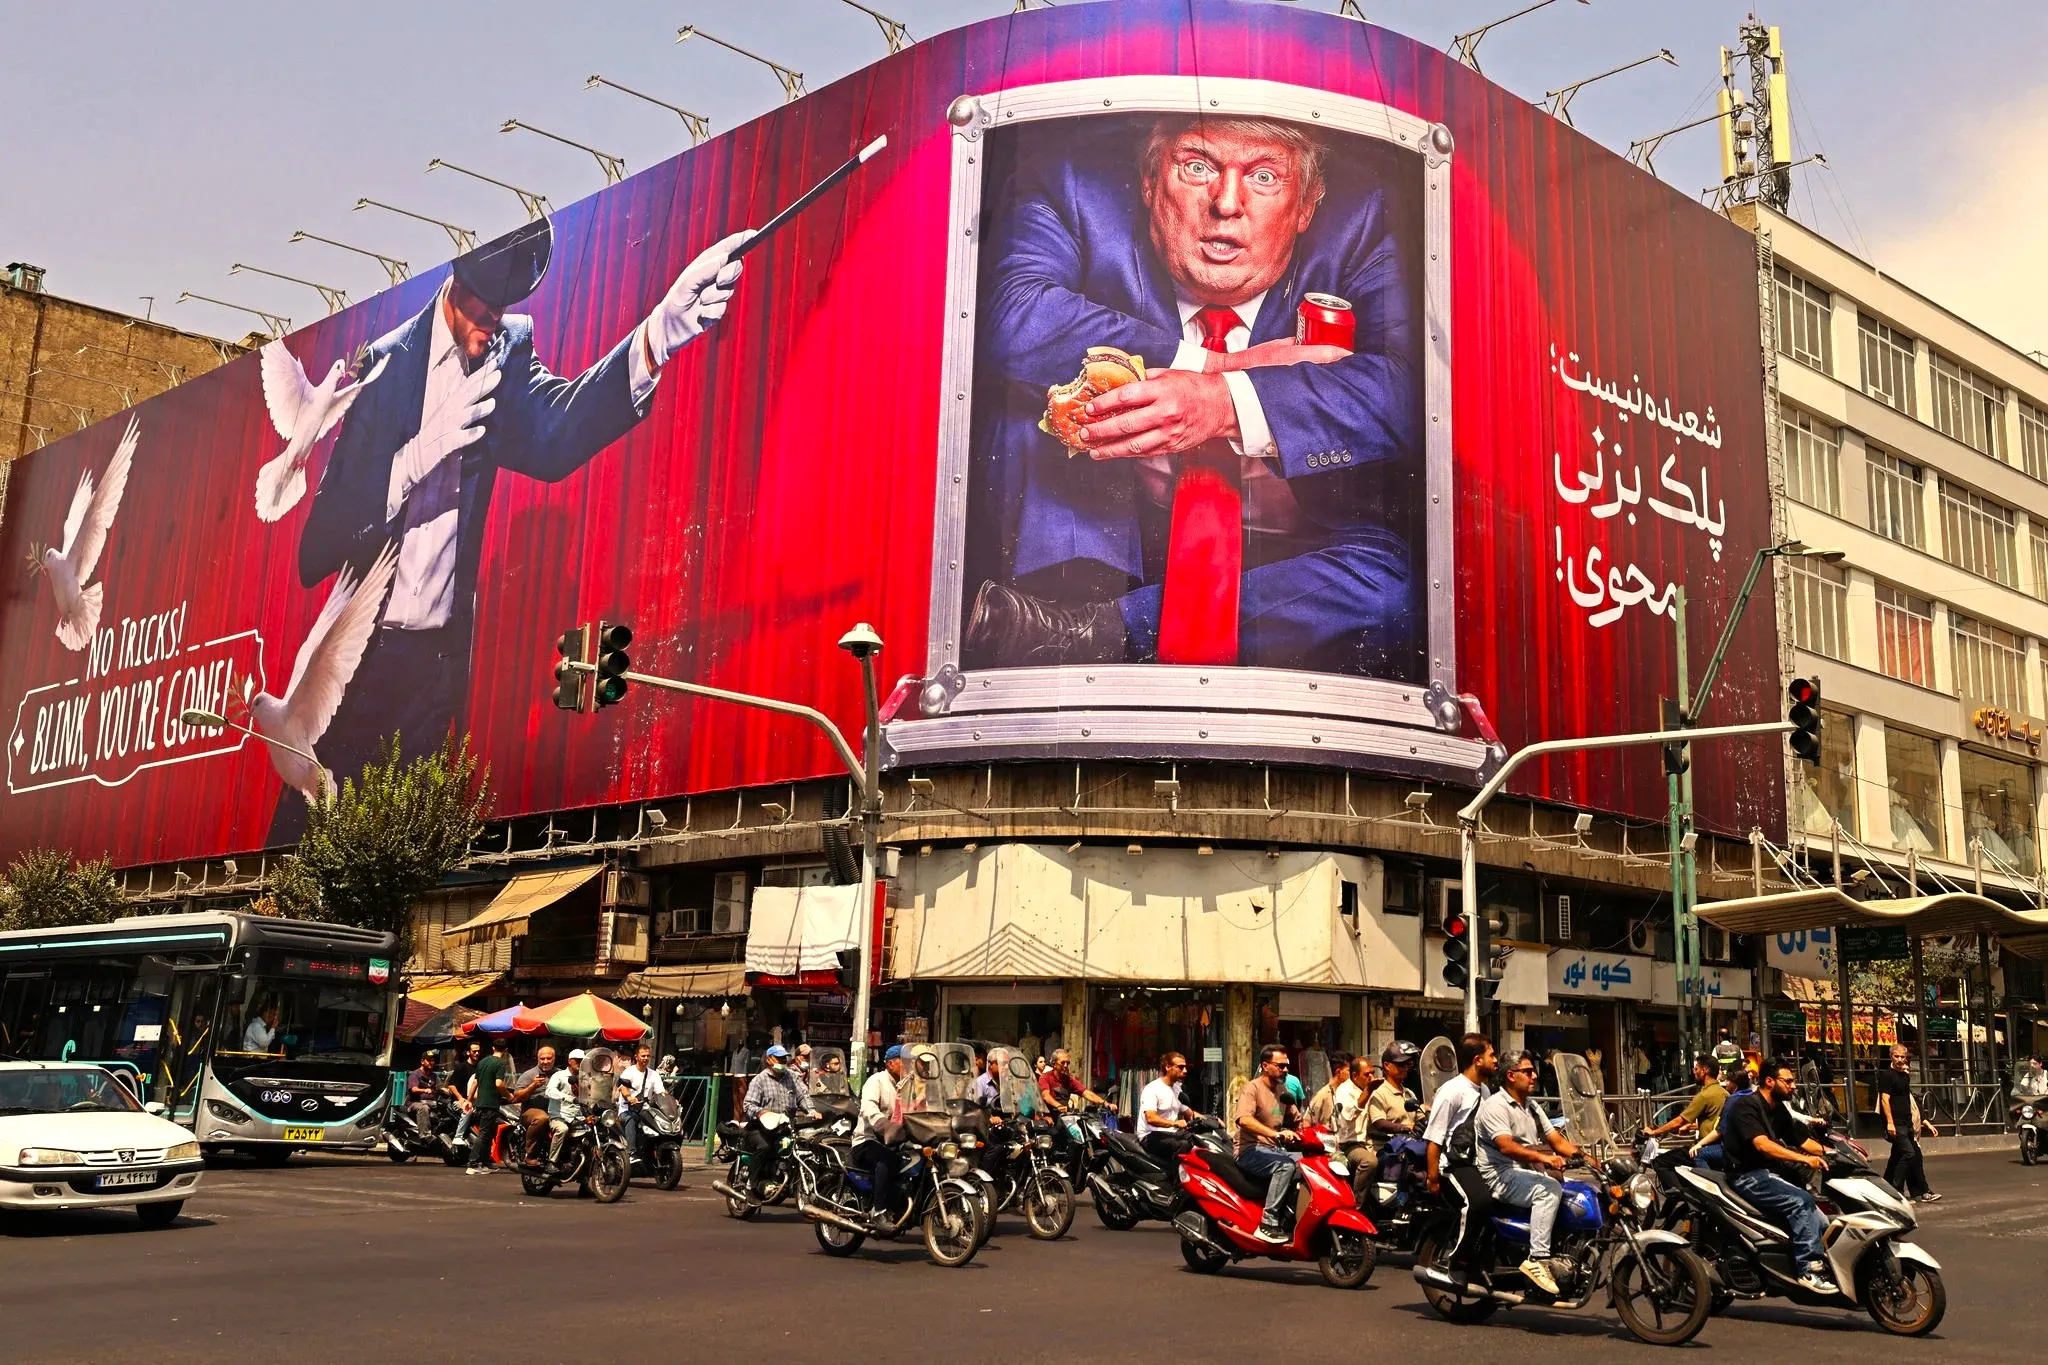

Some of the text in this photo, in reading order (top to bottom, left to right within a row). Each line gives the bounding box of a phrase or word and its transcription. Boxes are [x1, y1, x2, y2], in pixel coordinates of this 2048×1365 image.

[1645, 393, 1722, 449] شعبده
[1554, 426, 1726, 563] پلک بزنی
[86, 600, 187, 682] NO TRICKS!
[30, 657, 233, 775] BLINK, YOU'RE GONE!
[1563, 955, 1631, 991] کوه نور
